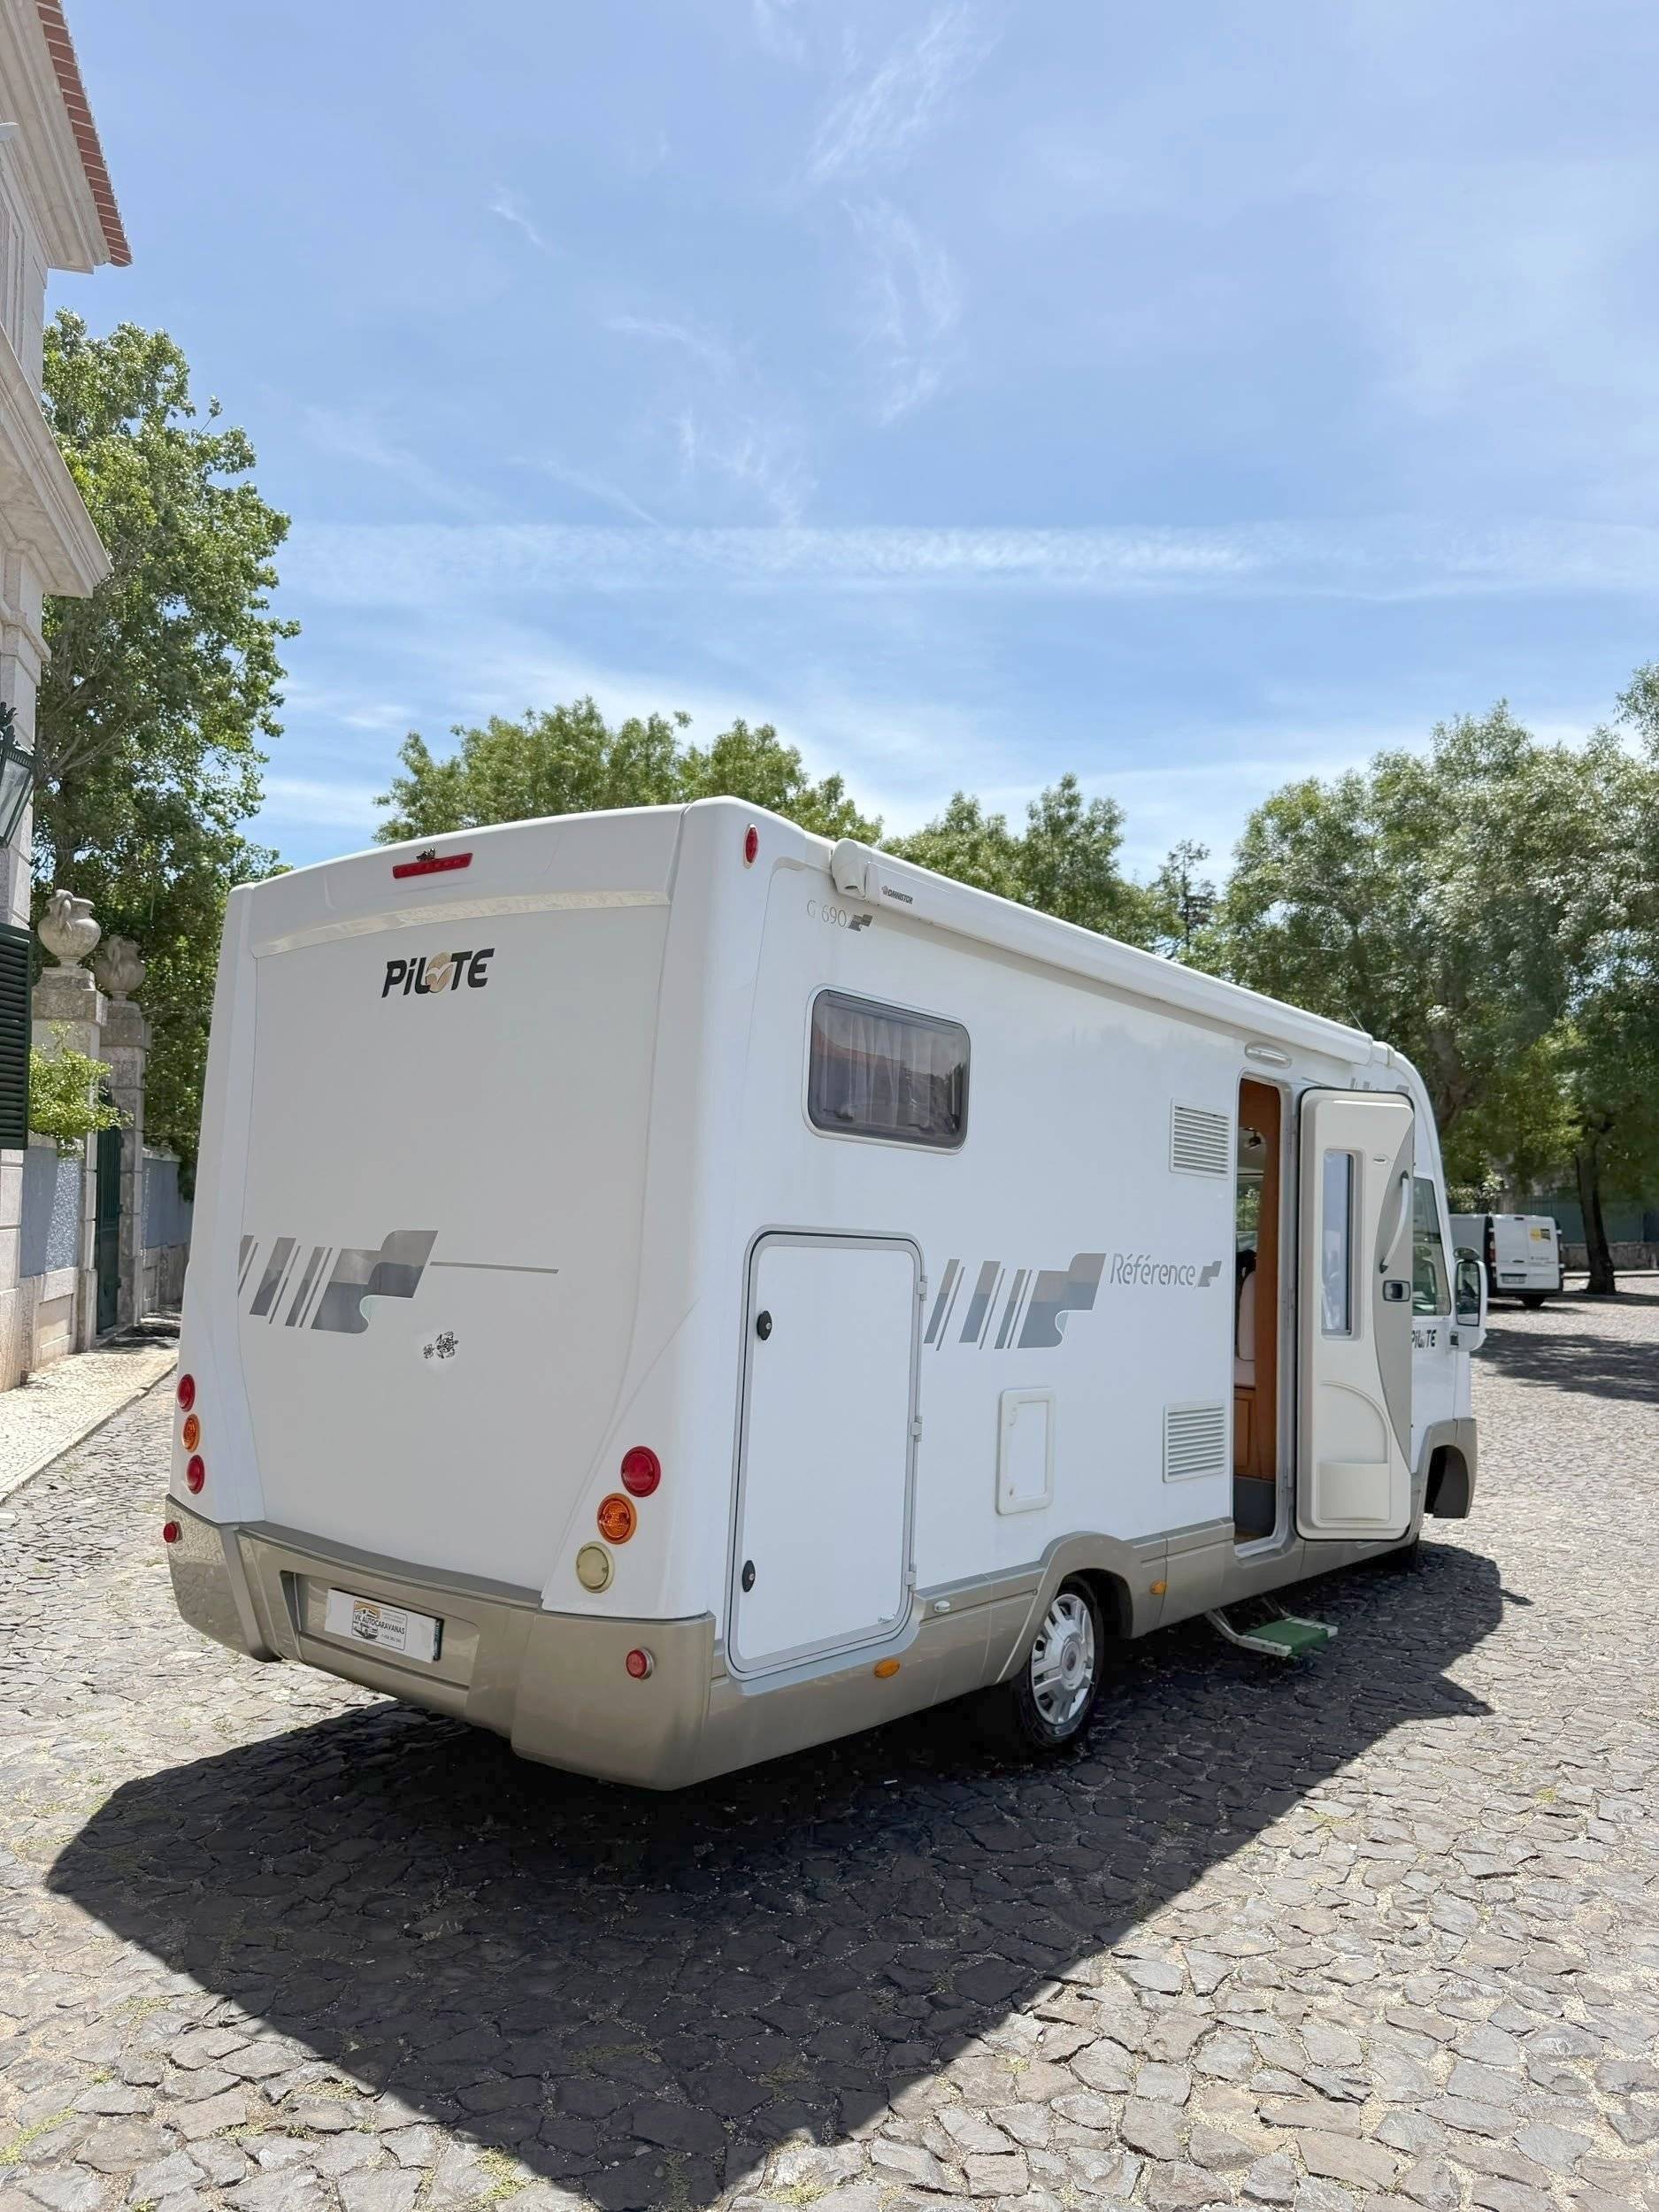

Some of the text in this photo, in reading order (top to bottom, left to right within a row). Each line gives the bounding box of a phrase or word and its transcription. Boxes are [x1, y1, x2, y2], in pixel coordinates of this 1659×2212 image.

[887, 888, 913, 904] OMNISTOR
[821, 904, 847, 927] 690
[1110, 1253, 1196, 1286] Référence
[362, 1616, 405, 1634] AUTOCARAVANAS
